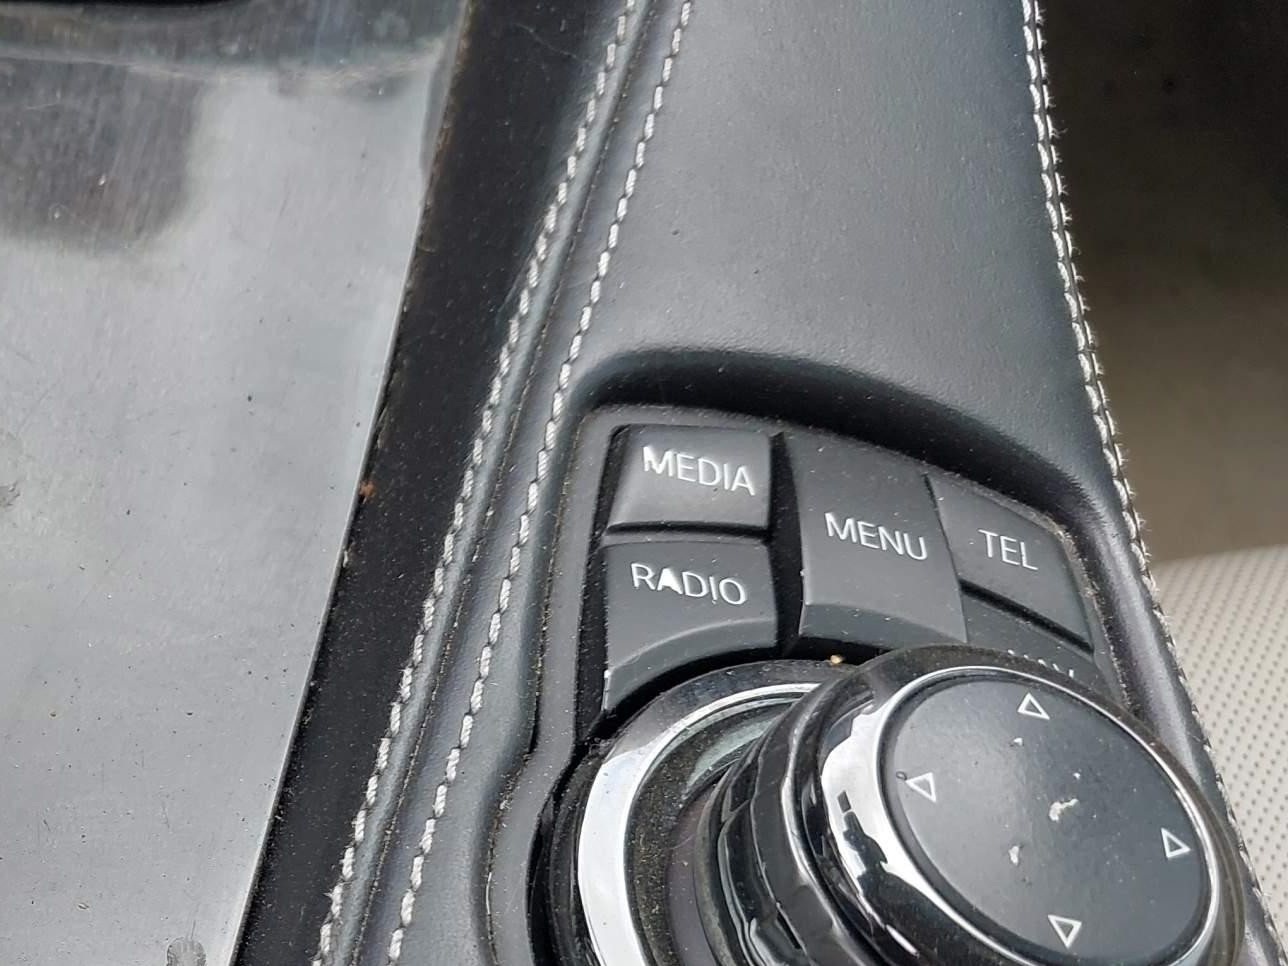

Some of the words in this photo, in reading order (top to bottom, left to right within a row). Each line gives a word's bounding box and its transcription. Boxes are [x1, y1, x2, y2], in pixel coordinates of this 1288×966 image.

[642, 445, 756, 497] MEDIA
[824, 511, 929, 562] MENU
[979, 528, 1039, 572] TEL
[631, 563, 749, 607] RADIO
